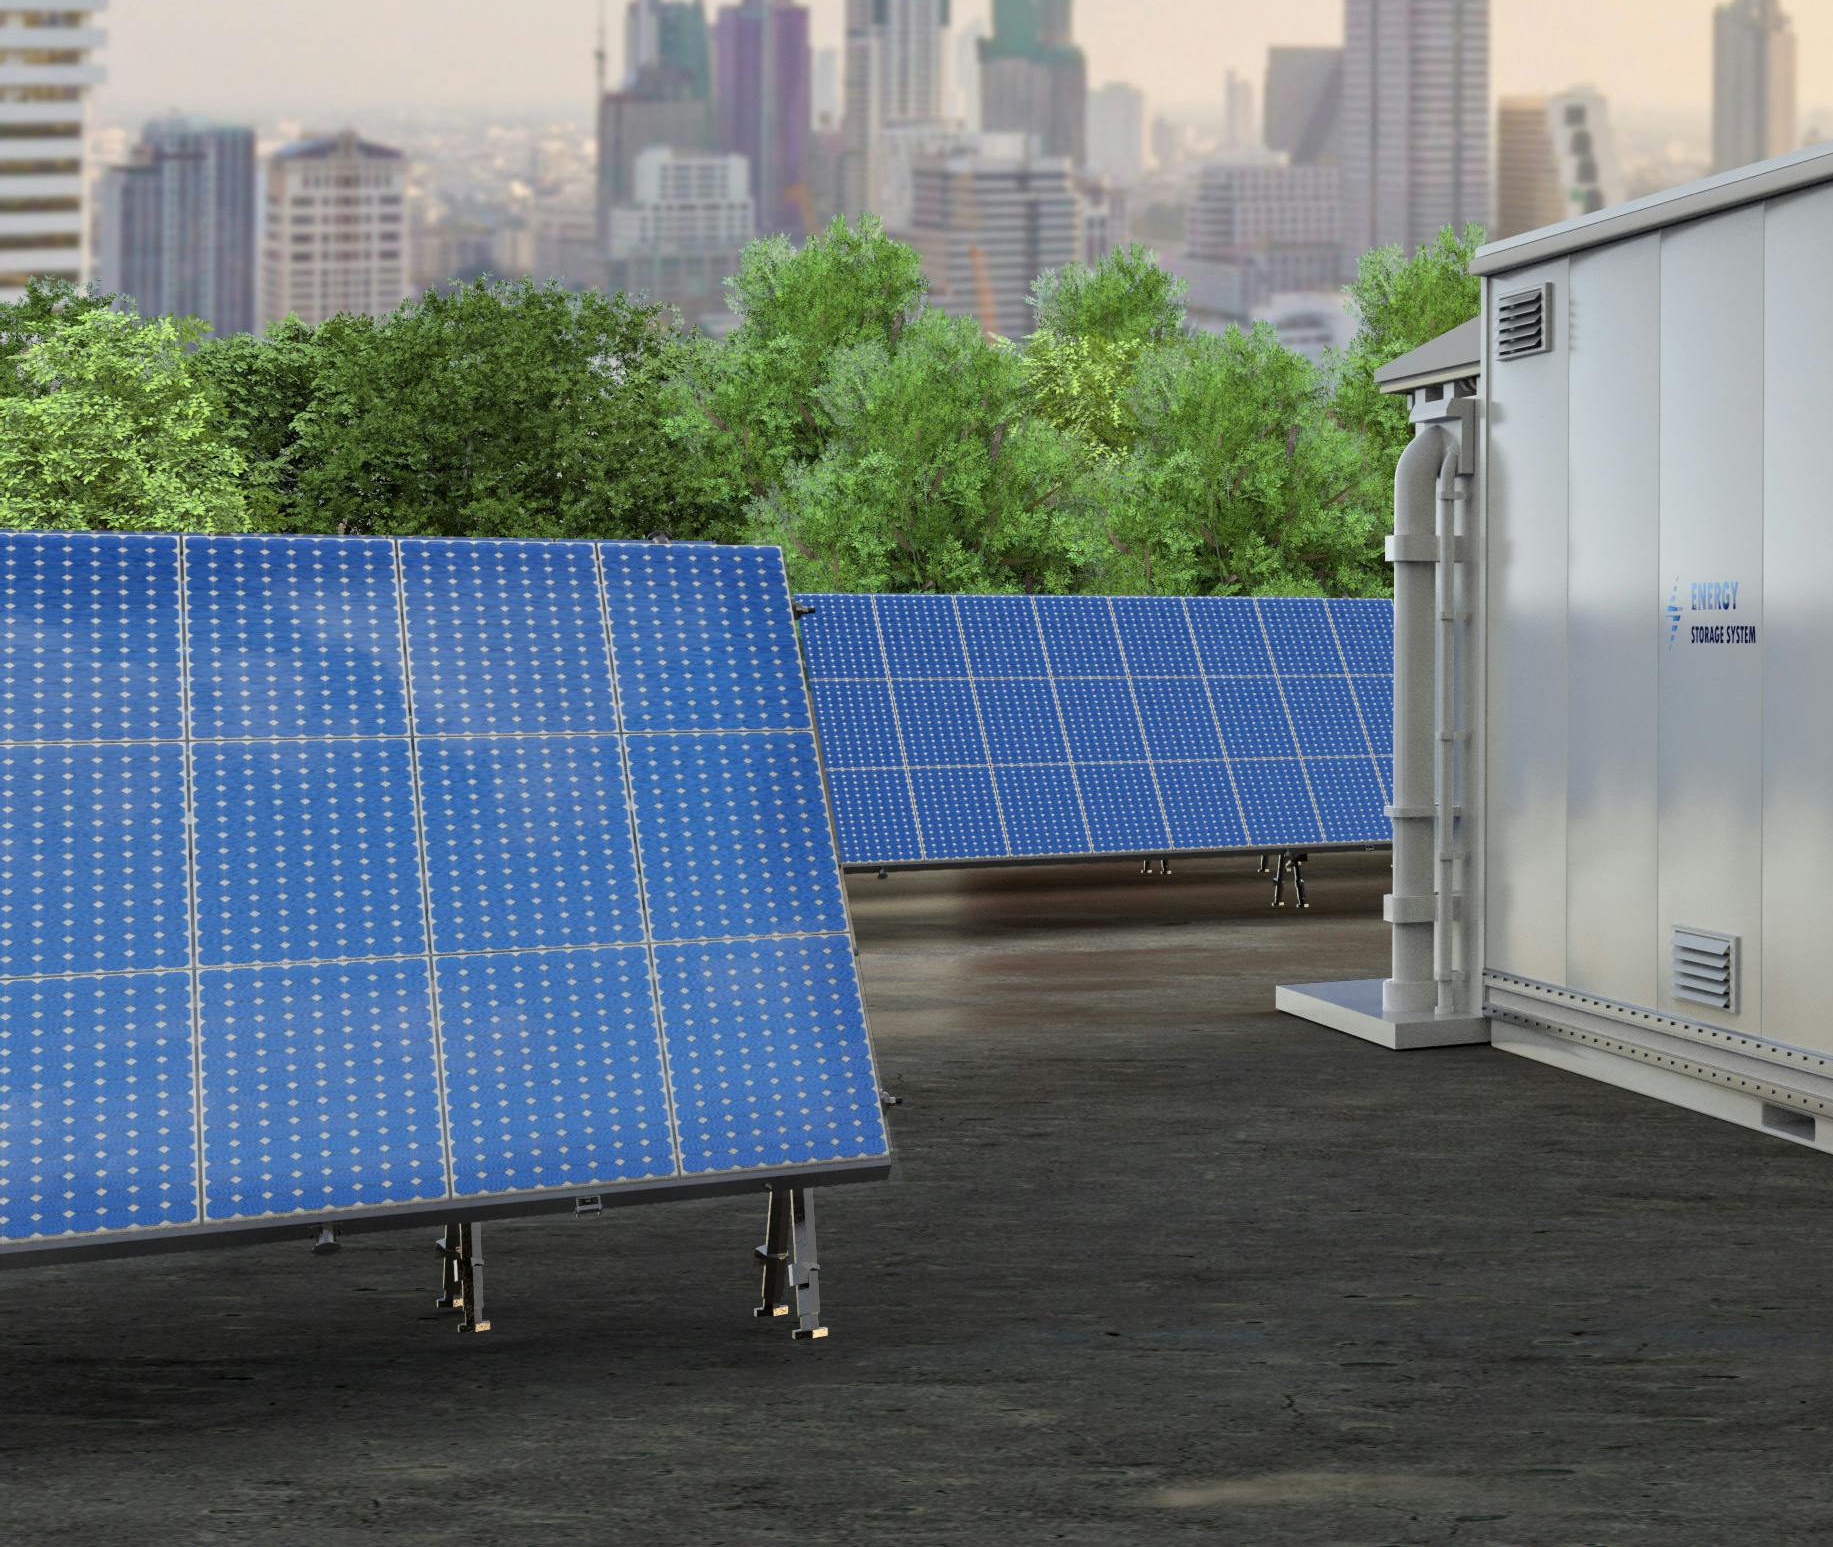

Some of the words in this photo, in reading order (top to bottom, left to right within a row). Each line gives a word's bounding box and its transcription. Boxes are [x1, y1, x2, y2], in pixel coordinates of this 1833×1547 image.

[1691, 581, 1739, 610] ENERGY
[1691, 625, 1724, 644] STORAGE
[1726, 625, 1756, 644] SYSTEM
